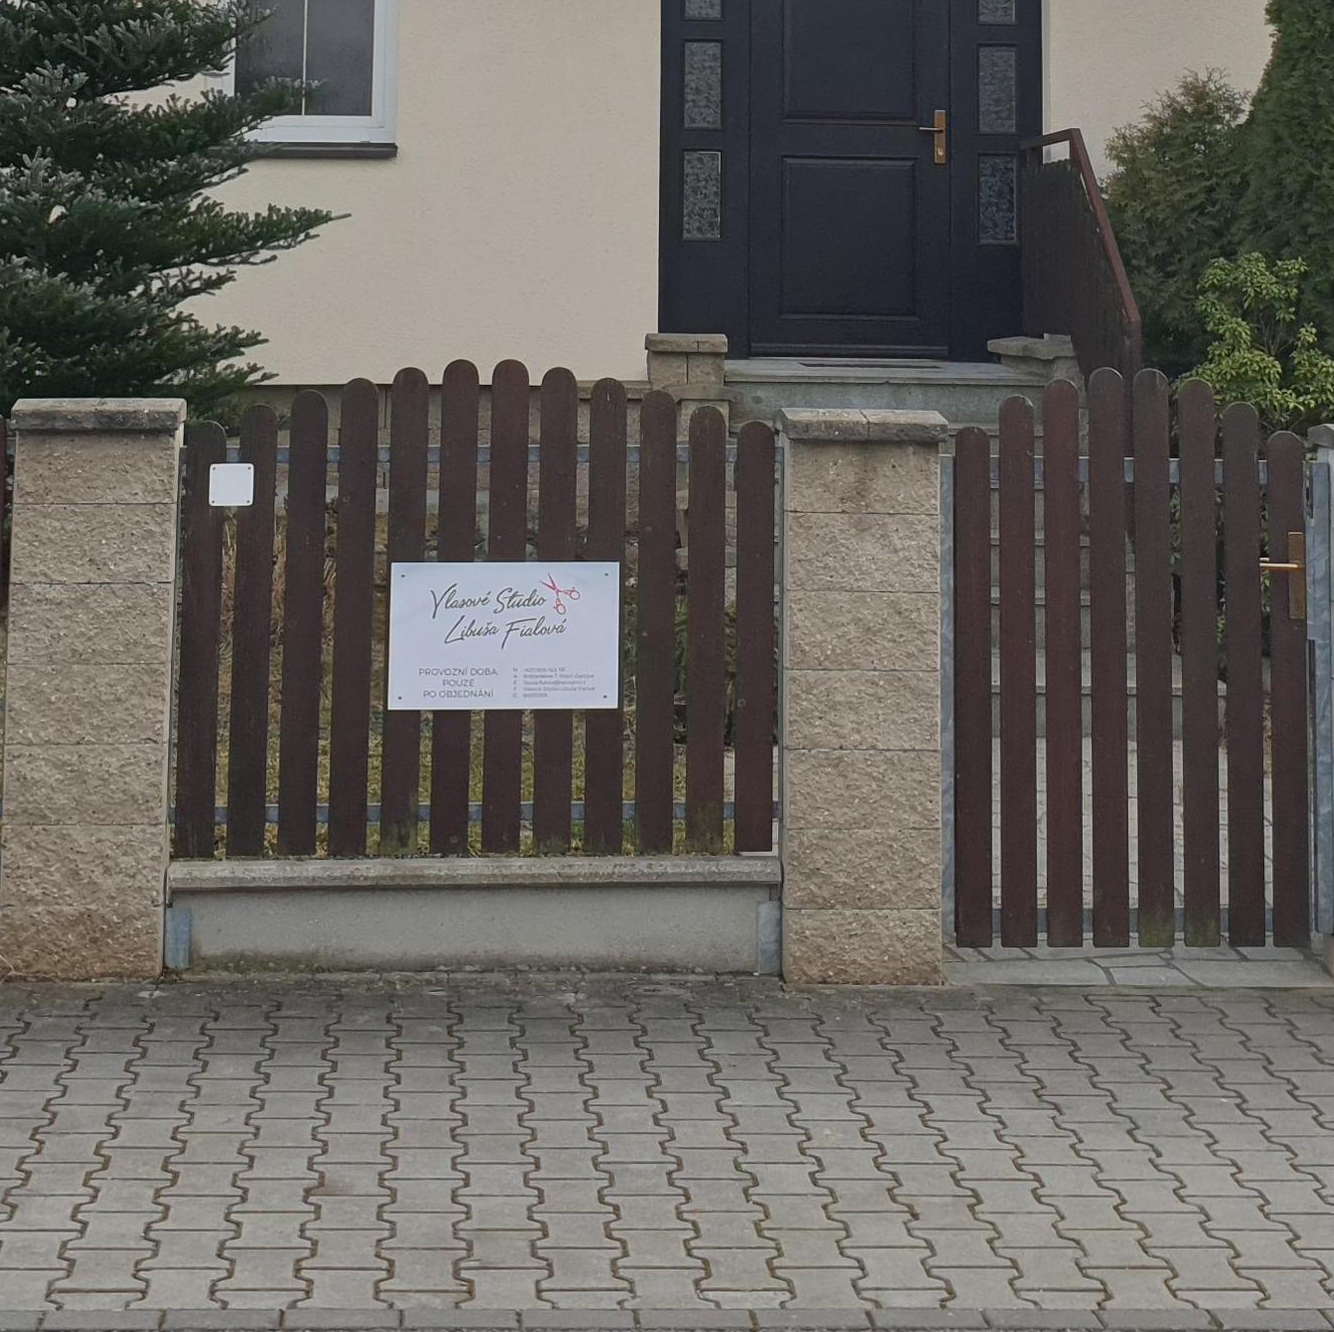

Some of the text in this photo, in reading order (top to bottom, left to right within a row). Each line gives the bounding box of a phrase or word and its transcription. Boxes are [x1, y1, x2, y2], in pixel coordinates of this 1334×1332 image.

[430, 583, 548, 619] Vlasové Studio
[501, 615, 567, 649] Fialová
[418, 666, 499, 676] PROVOZNÍ DOBA
[442, 678, 475, 687] POUZE
[423, 688, 494, 699] PO OBJEDNÁNÍ
